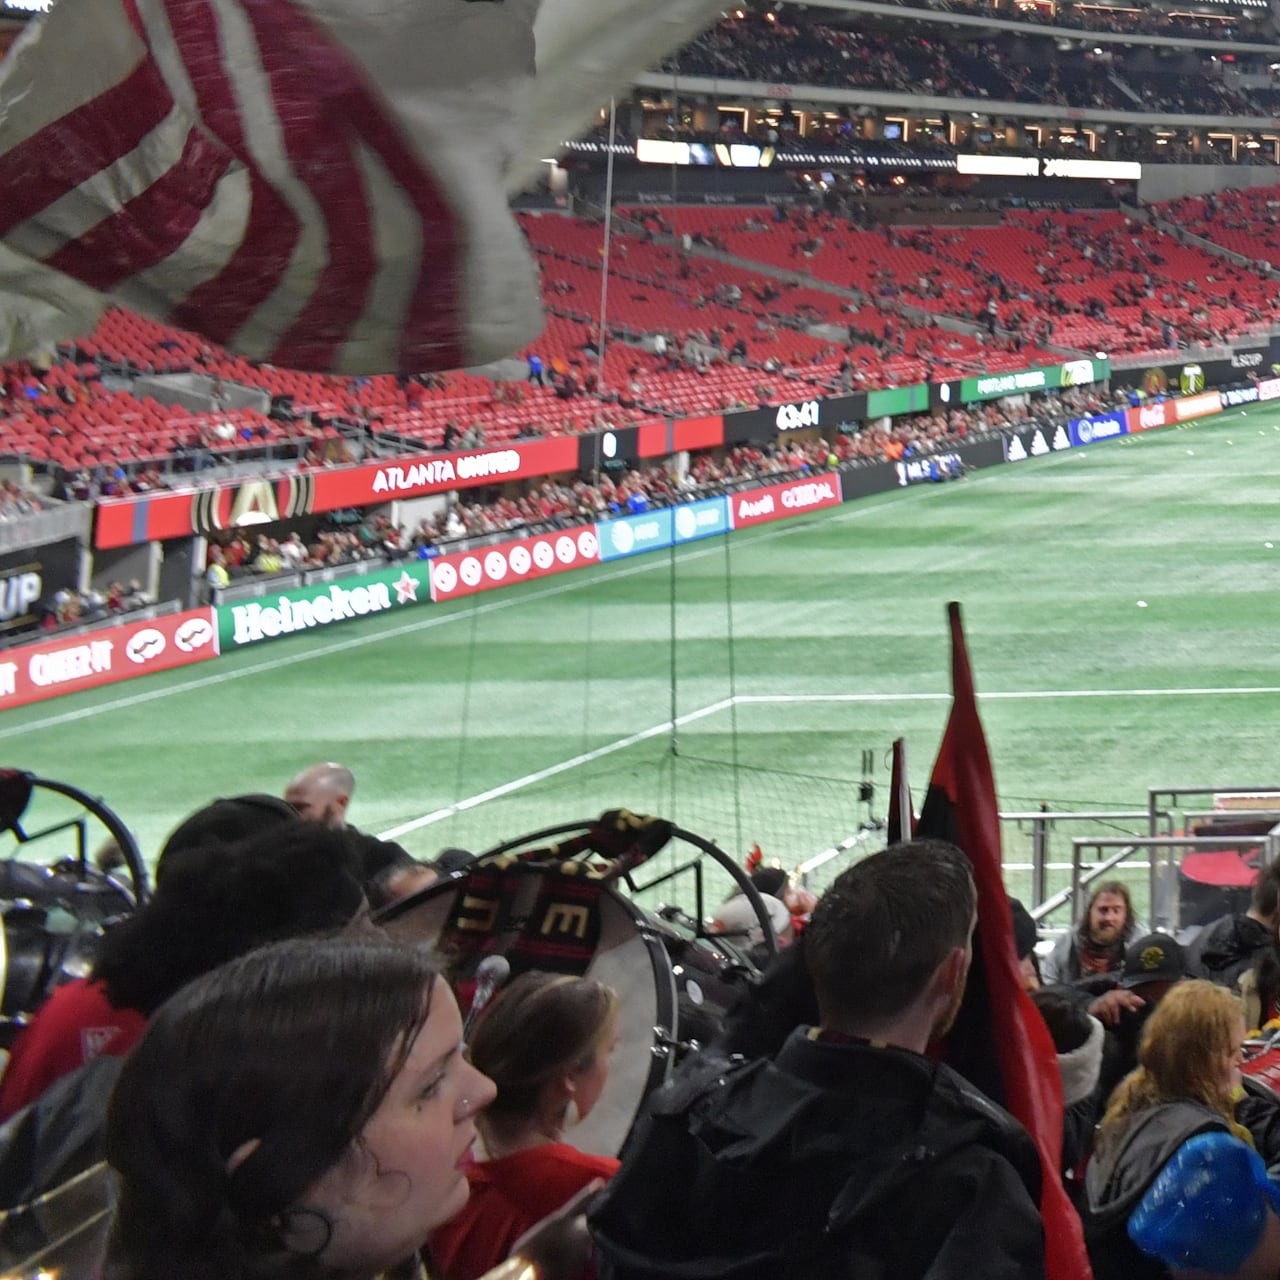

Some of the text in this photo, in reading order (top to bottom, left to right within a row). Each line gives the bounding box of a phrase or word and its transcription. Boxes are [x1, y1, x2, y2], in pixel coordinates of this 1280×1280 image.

[371, 449, 521, 494] ATLANTA UNITED
[737, 494, 775, 519] Audi
[231, 581, 392, 645] Heineken
